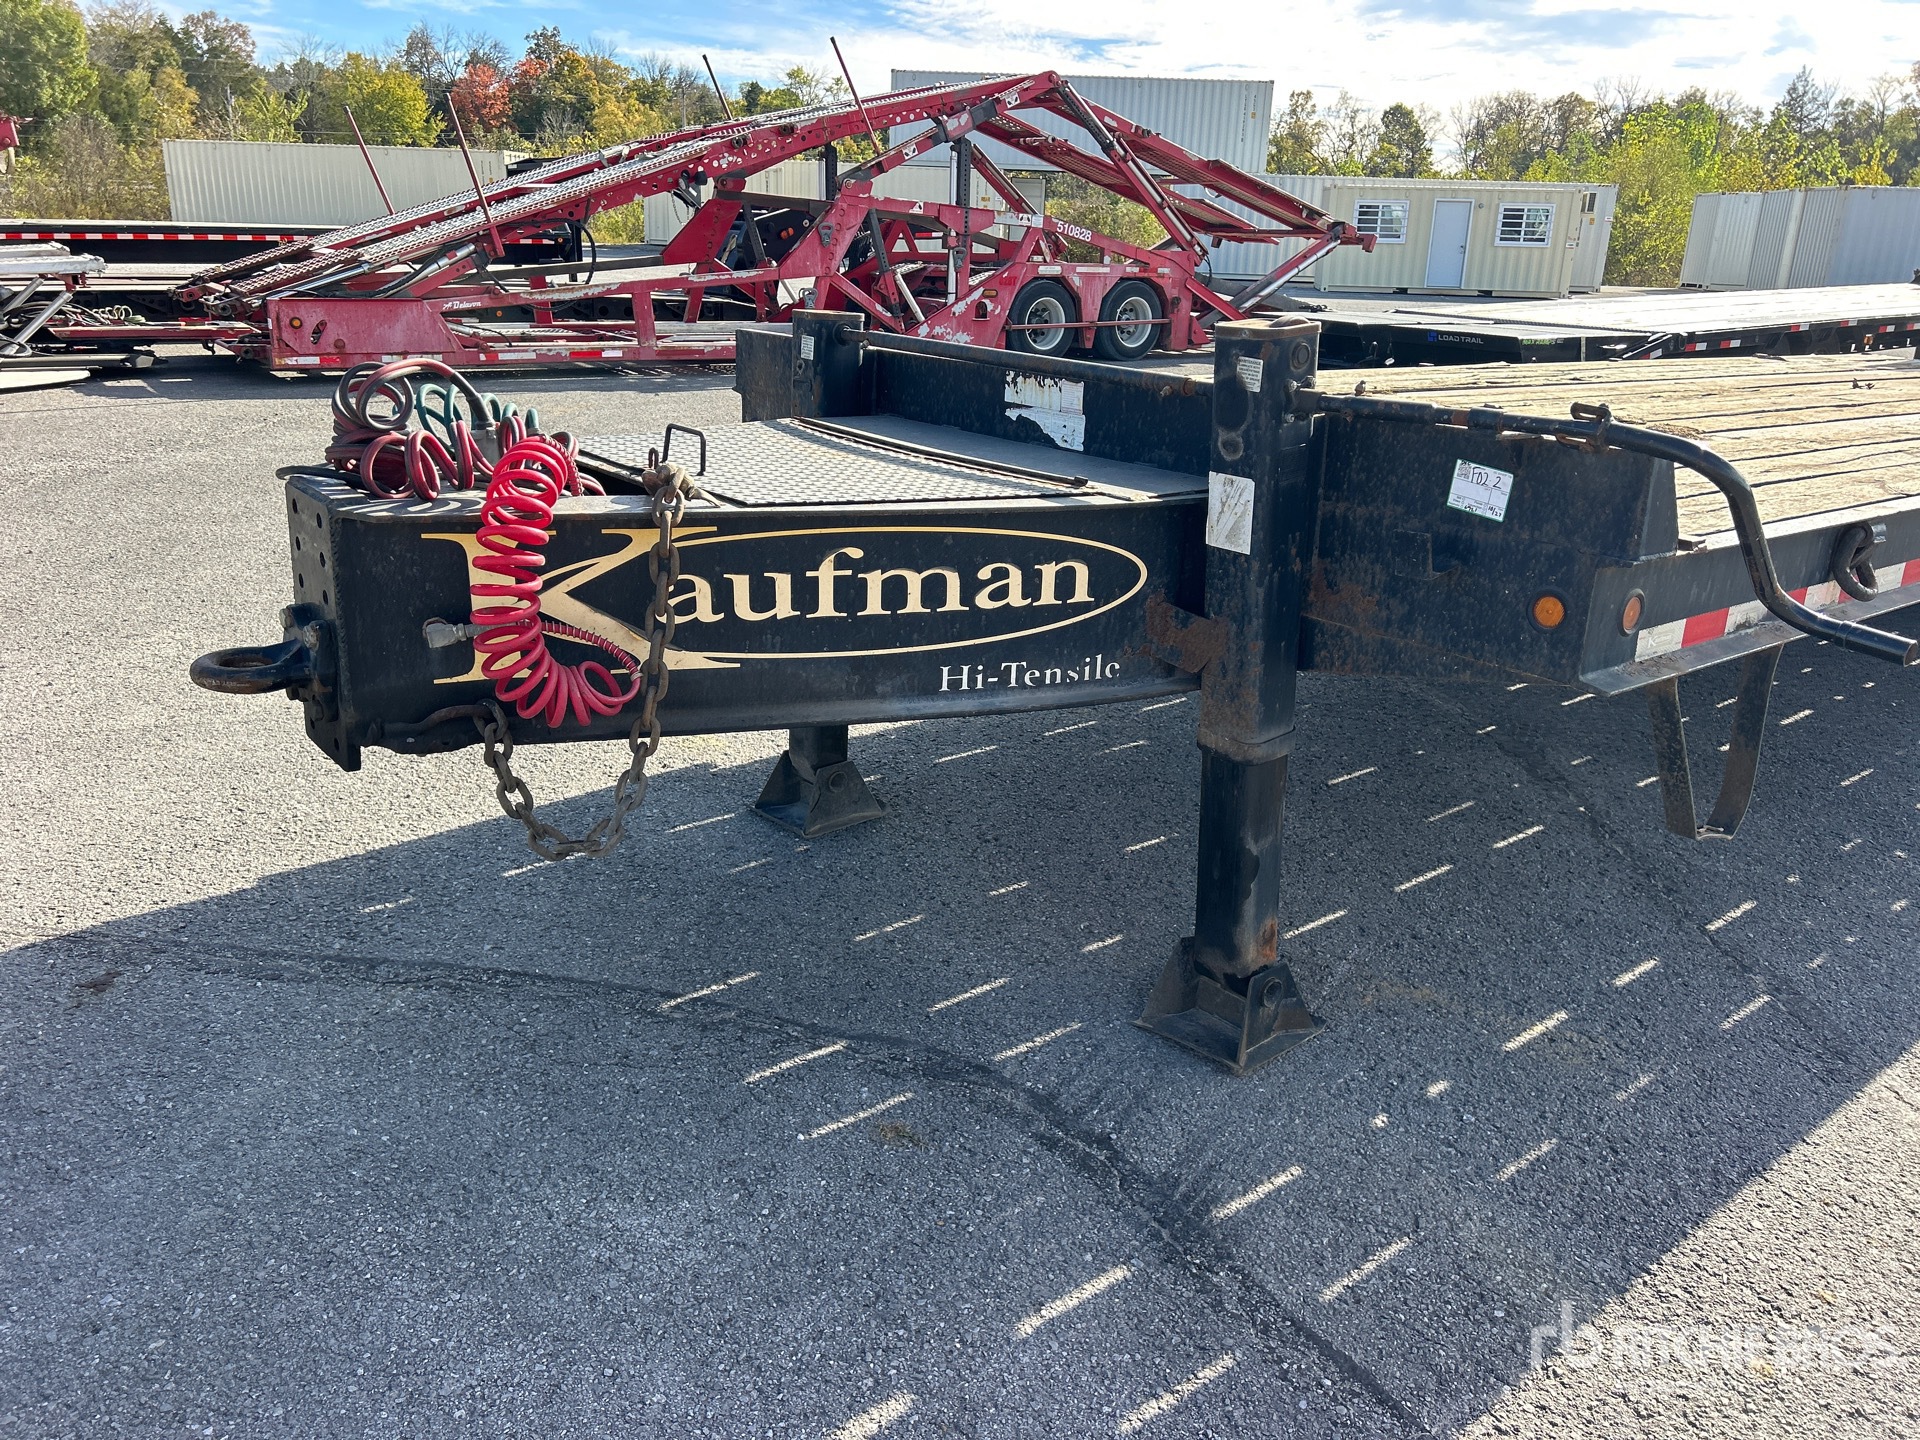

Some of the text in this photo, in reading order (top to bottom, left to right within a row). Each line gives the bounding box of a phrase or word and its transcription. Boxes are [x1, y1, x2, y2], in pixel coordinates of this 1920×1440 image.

[1056, 221, 1092, 242] 510828
[1438, 334, 1484, 344] LOAD TRAIL
[421, 525, 1095, 684] Kaufman
